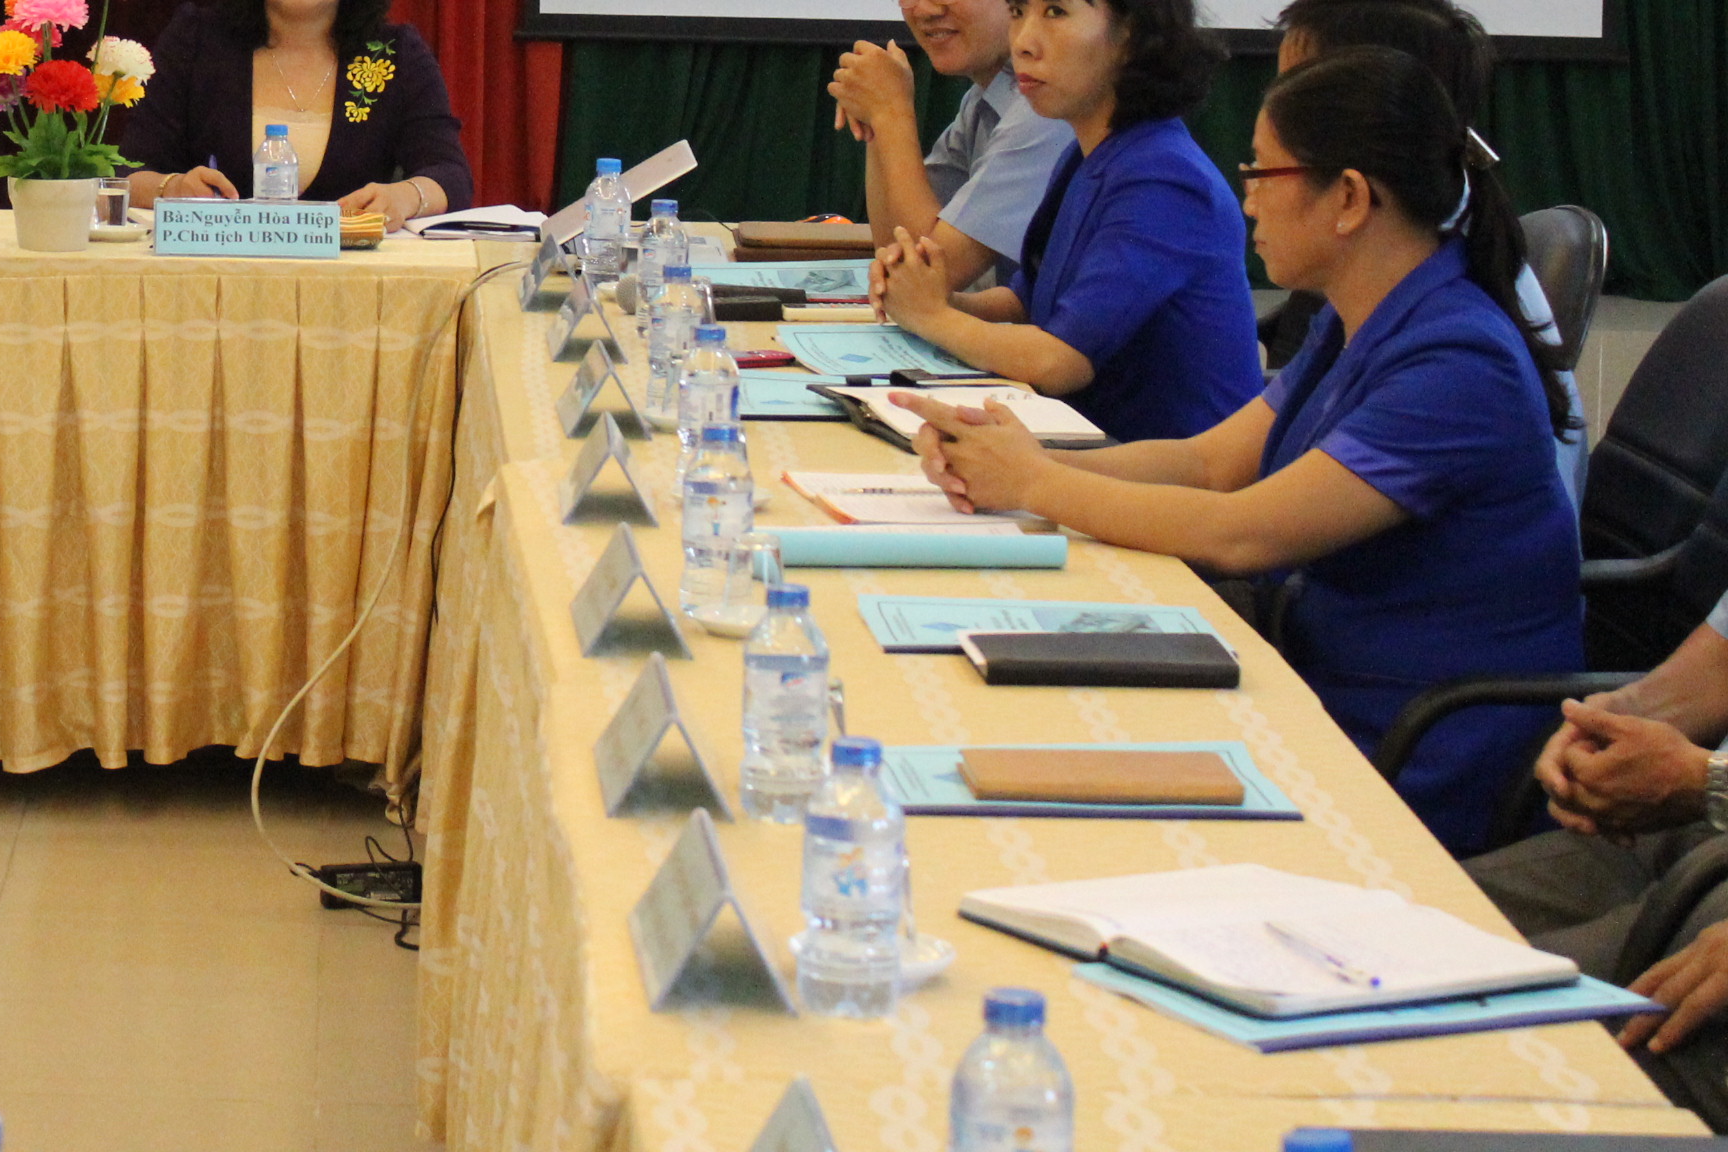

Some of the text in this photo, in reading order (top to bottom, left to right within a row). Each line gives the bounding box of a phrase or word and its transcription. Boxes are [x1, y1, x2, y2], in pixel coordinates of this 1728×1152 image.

[257, 211, 291, 225] Hòa
[296, 211, 334, 229] Hiệp
[215, 230, 243, 246] tịch
[248, 231, 298, 244] UBND
